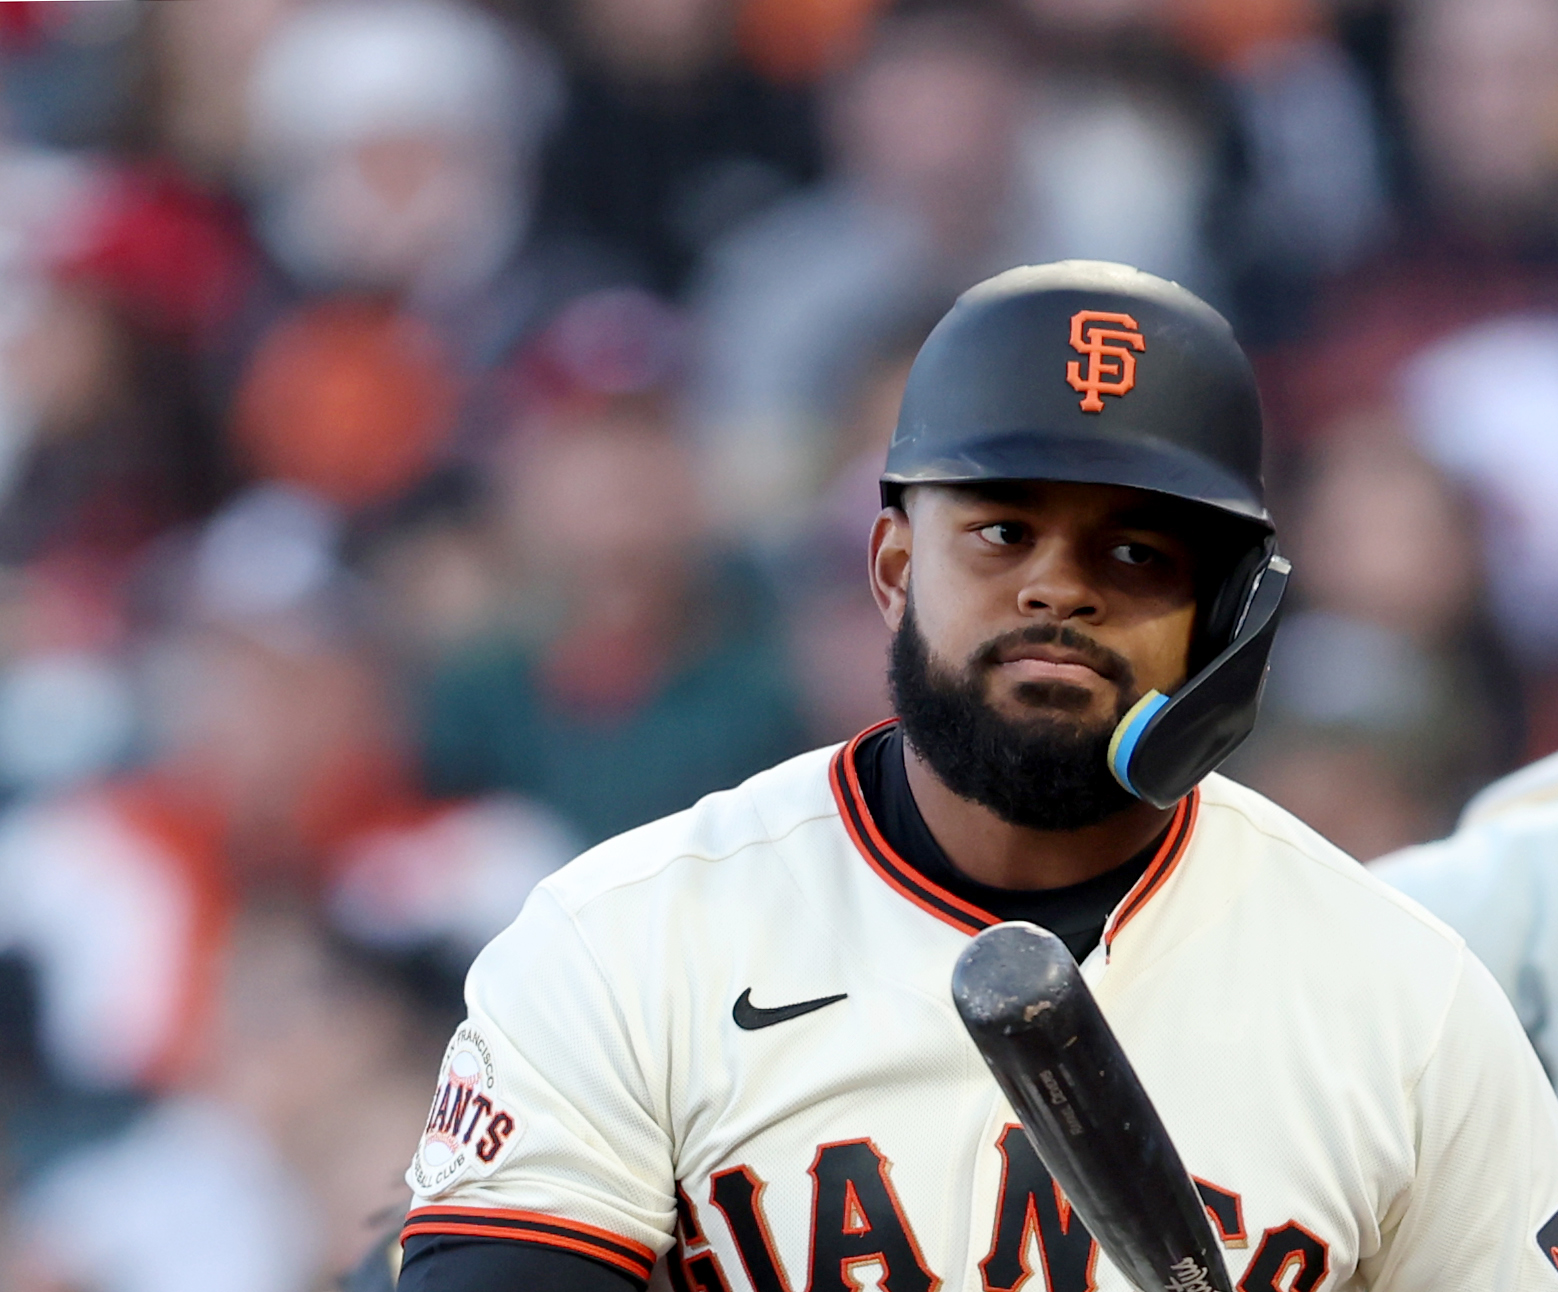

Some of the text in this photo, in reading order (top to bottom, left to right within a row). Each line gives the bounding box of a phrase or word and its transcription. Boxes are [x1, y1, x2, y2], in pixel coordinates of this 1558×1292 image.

[1066, 309, 1146, 412] SF
[425, 1083, 516, 1165] IANTS
[435, 1153, 466, 1185] CLUB
